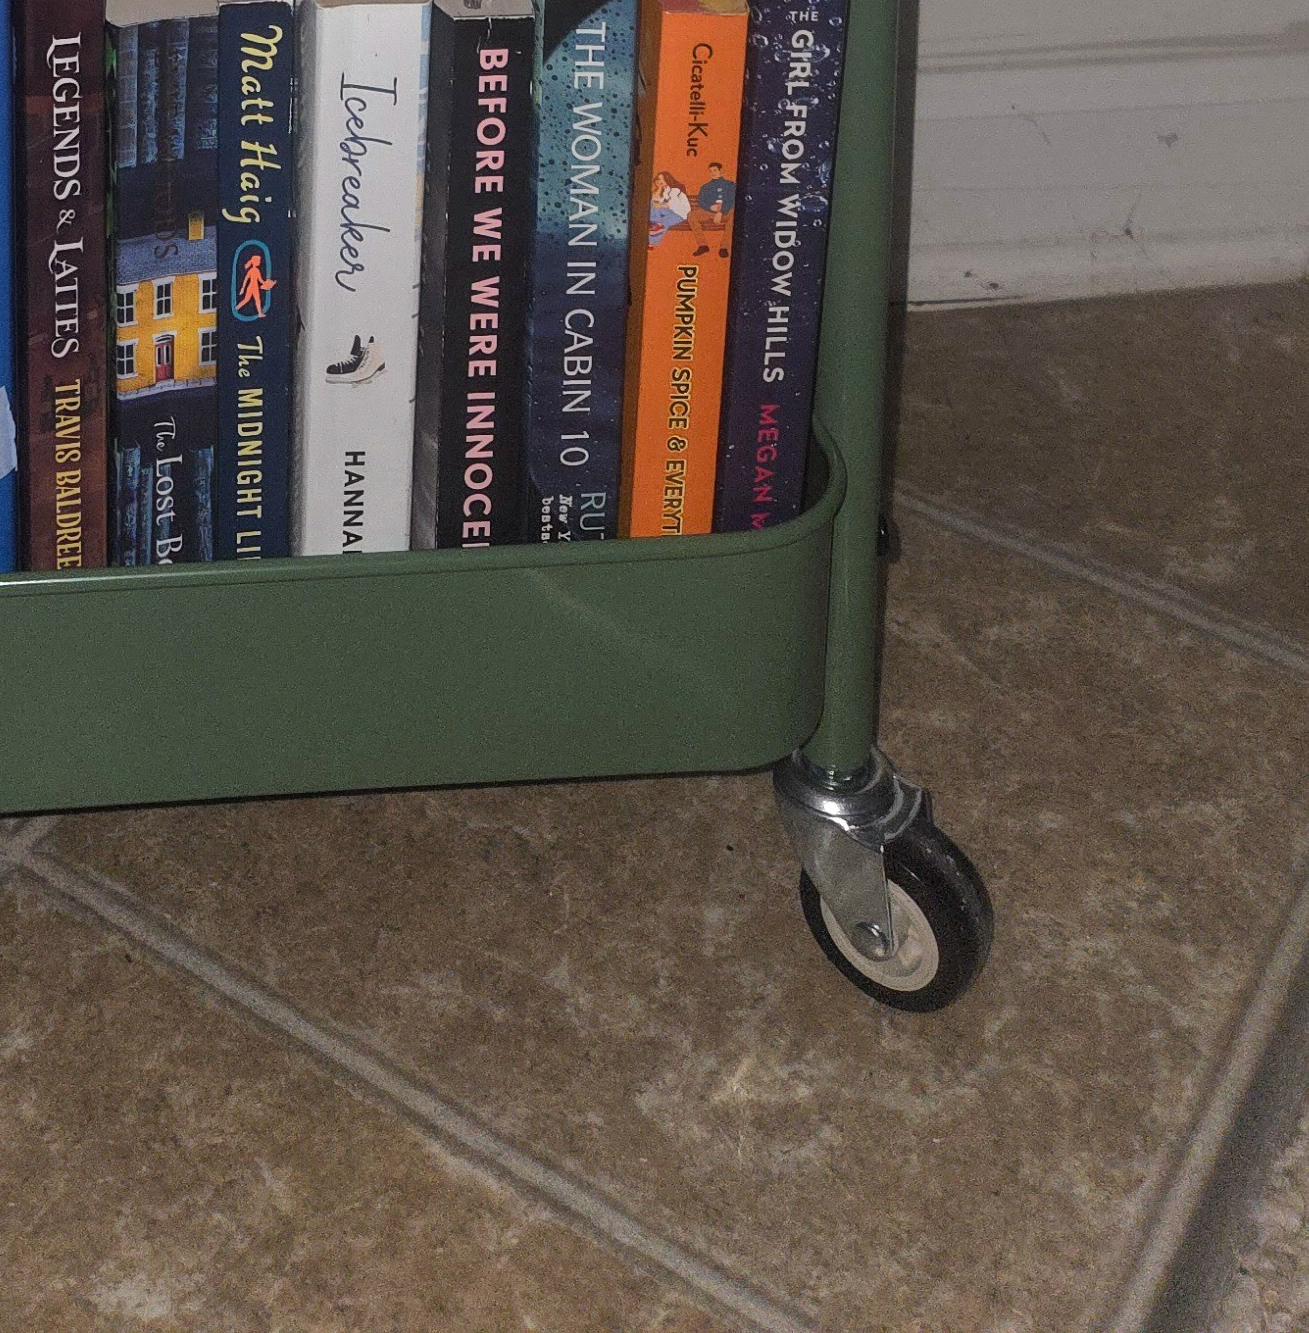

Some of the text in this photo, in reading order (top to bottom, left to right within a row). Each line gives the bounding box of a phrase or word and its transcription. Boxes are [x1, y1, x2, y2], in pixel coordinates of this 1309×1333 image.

[788, 28, 814, 94] GIRL
[790, 10, 819, 23] THE
[237, 23, 284, 226] Matt Haig
[783, 94, 811, 186] FROM
[335, 71, 399, 294] Icebreaker
[558, 20, 606, 540] THE WOMAN IN CABIN 10 RU
[770, 191, 800, 299] WIDOW
[47, 35, 84, 569] LEGENDS & LATTES TRAVIS BALDREE
[461, 47, 509, 550] BEFORE WE WERE INNOCE
[676, 262, 700, 360] PUMPKIN
[762, 306, 792, 384] HILLS
[236, 336, 264, 561] The MIDNIGHT LI
[671, 435, 687, 454] &
[672, 365, 693, 431] SPICE
[151, 415, 184, 564] The Lost B
[755, 403, 778, 503] MEGAN
